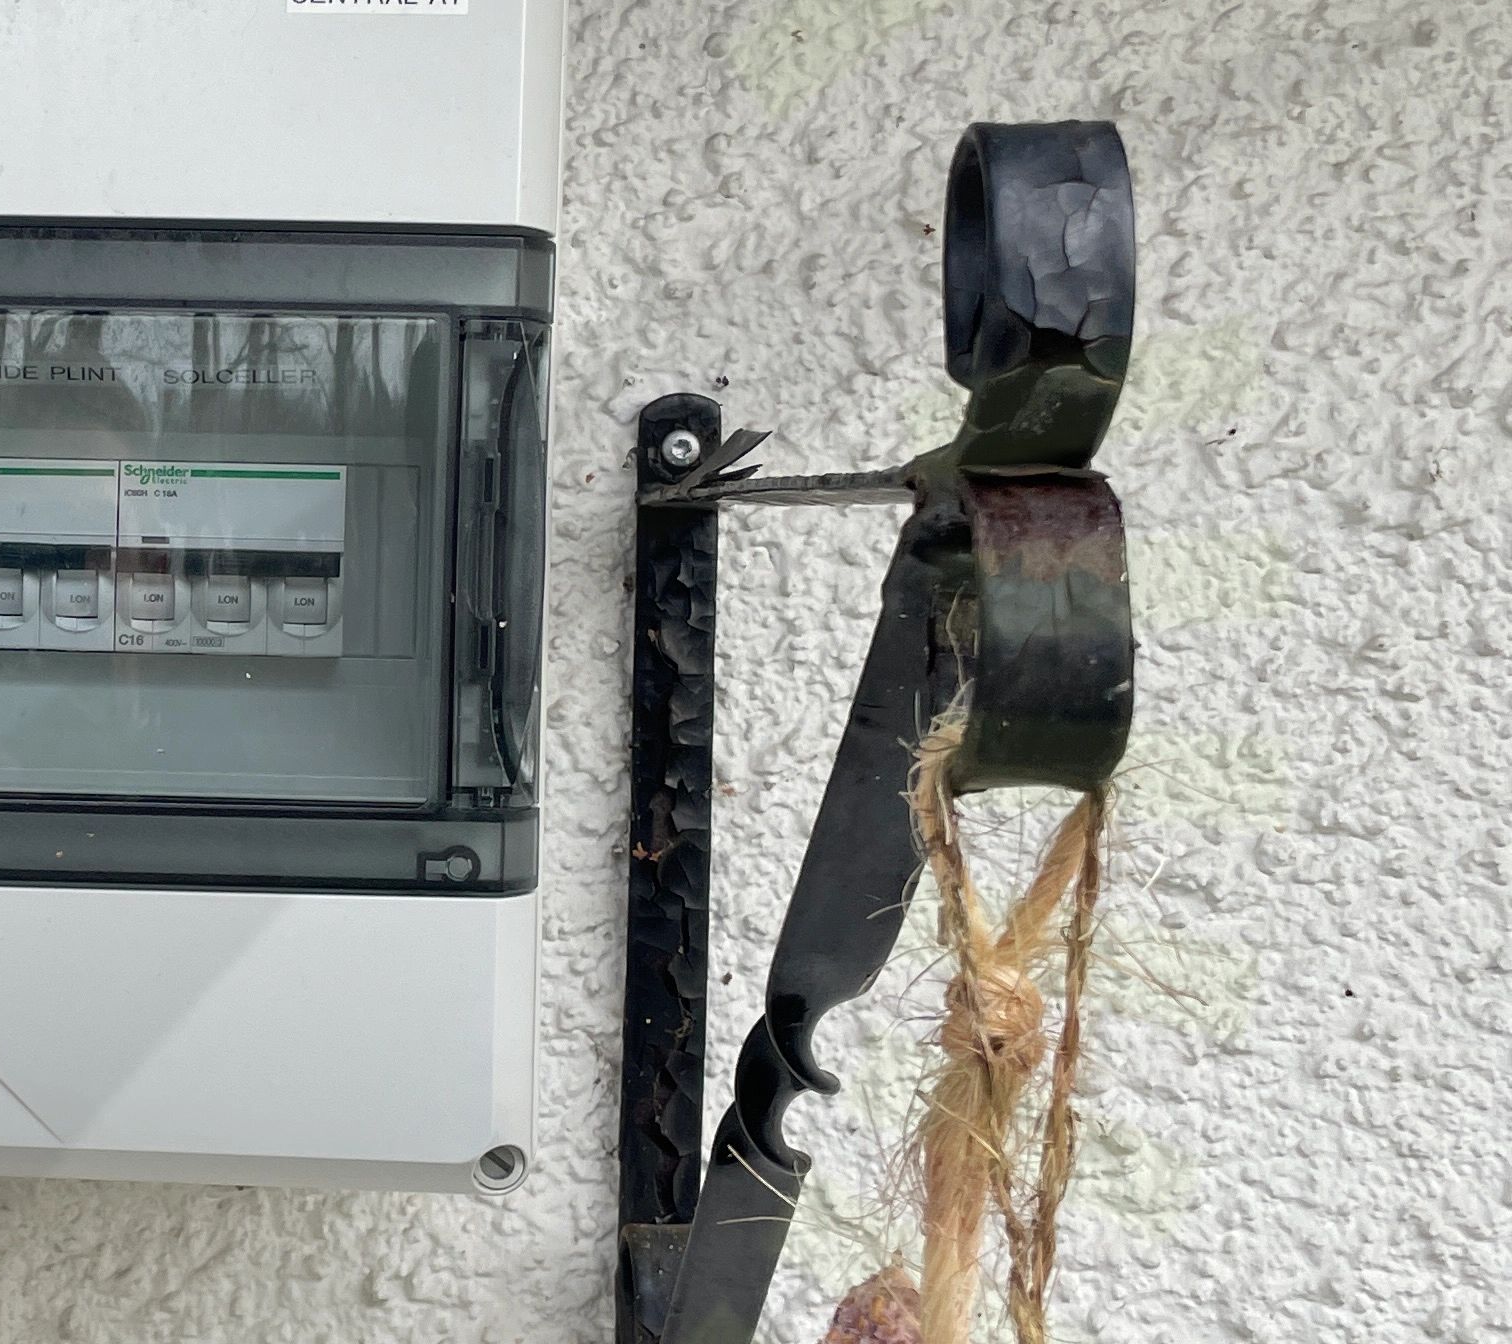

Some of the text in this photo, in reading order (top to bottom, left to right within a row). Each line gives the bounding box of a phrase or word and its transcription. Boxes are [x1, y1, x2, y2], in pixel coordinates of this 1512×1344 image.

[50, 366, 121, 381] PLINT
[163, 369, 316, 385] SOLCELLER
[124, 464, 189, 485] Schneider
[118, 634, 144, 646] C16
